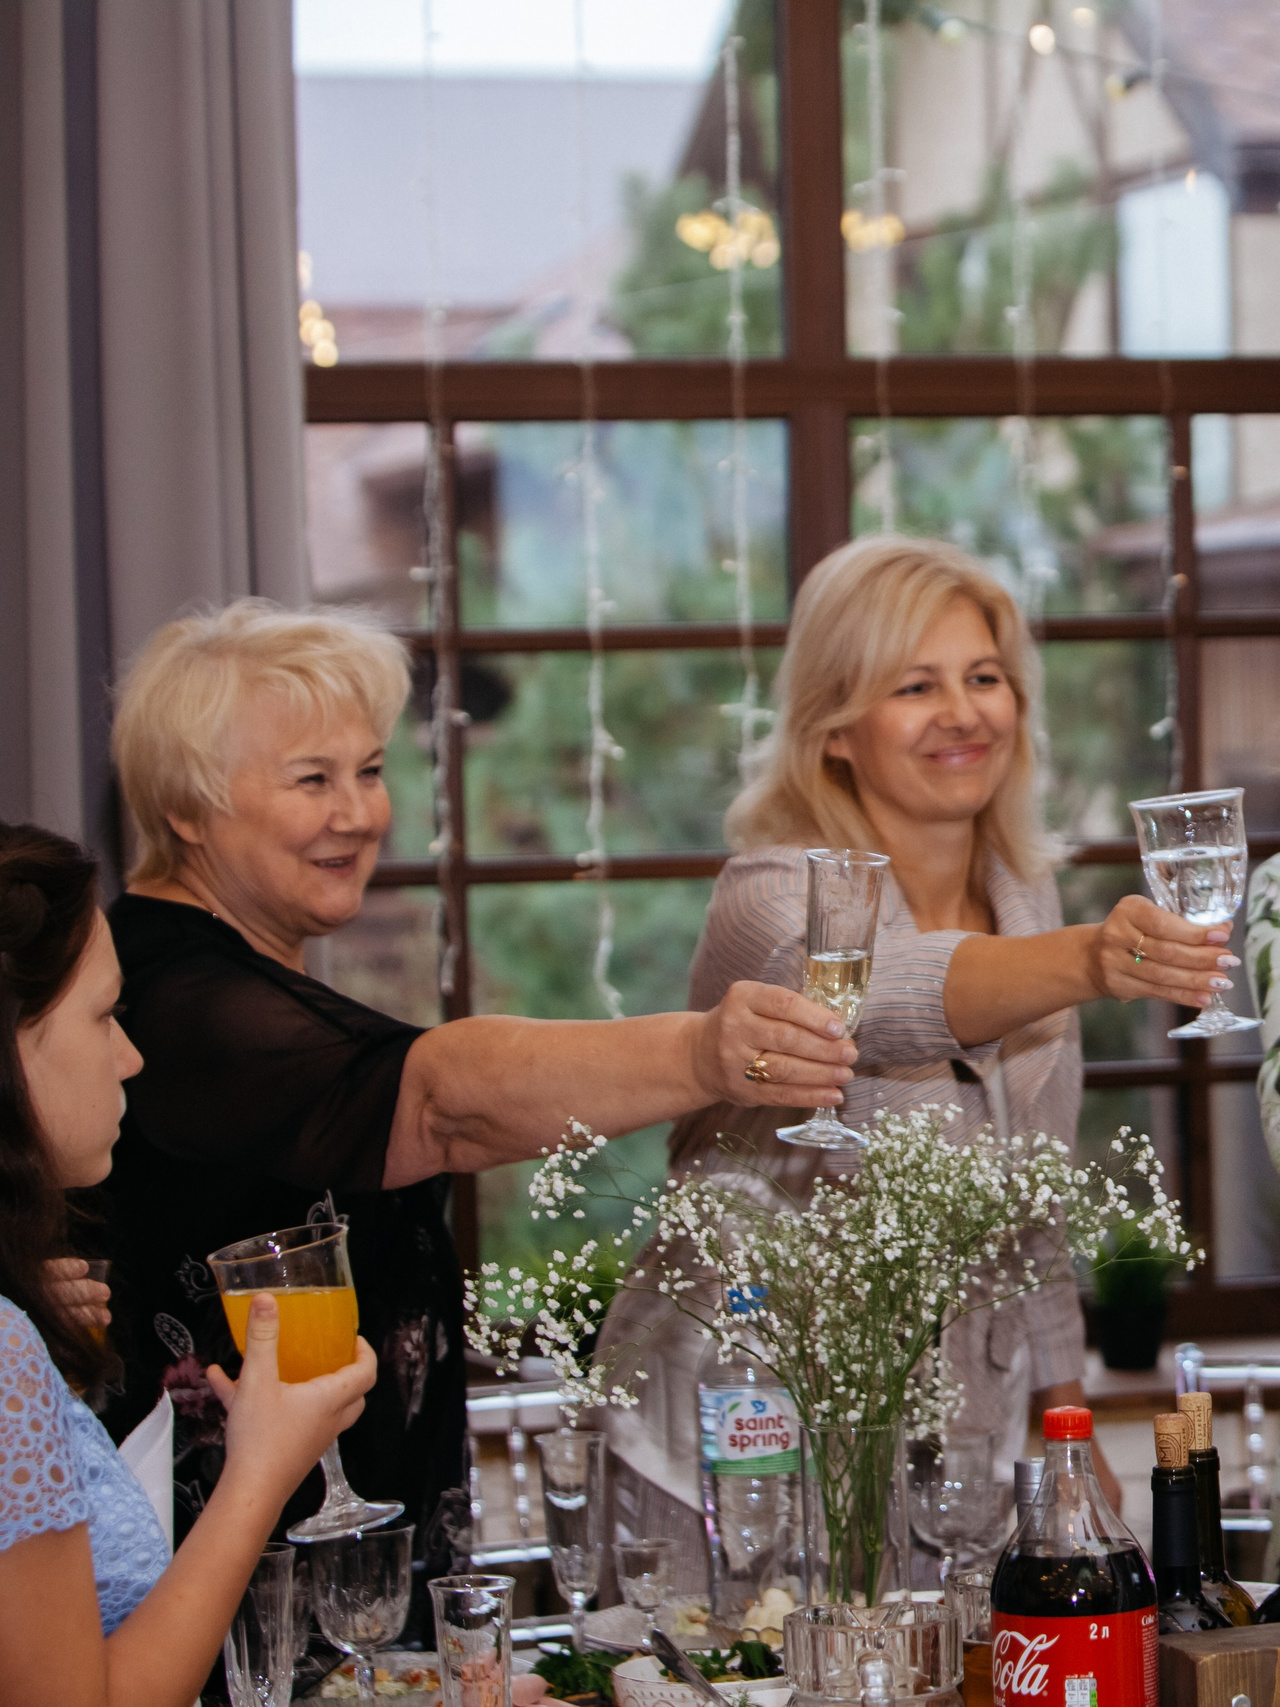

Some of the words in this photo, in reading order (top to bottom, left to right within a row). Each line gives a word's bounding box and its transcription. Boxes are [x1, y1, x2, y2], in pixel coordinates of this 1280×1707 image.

[734, 1413, 784, 1431] saint
[728, 1431, 790, 1452] spring
[1089, 1623, 1098, 1640] 2
[993, 1629, 1060, 1696] Cola
